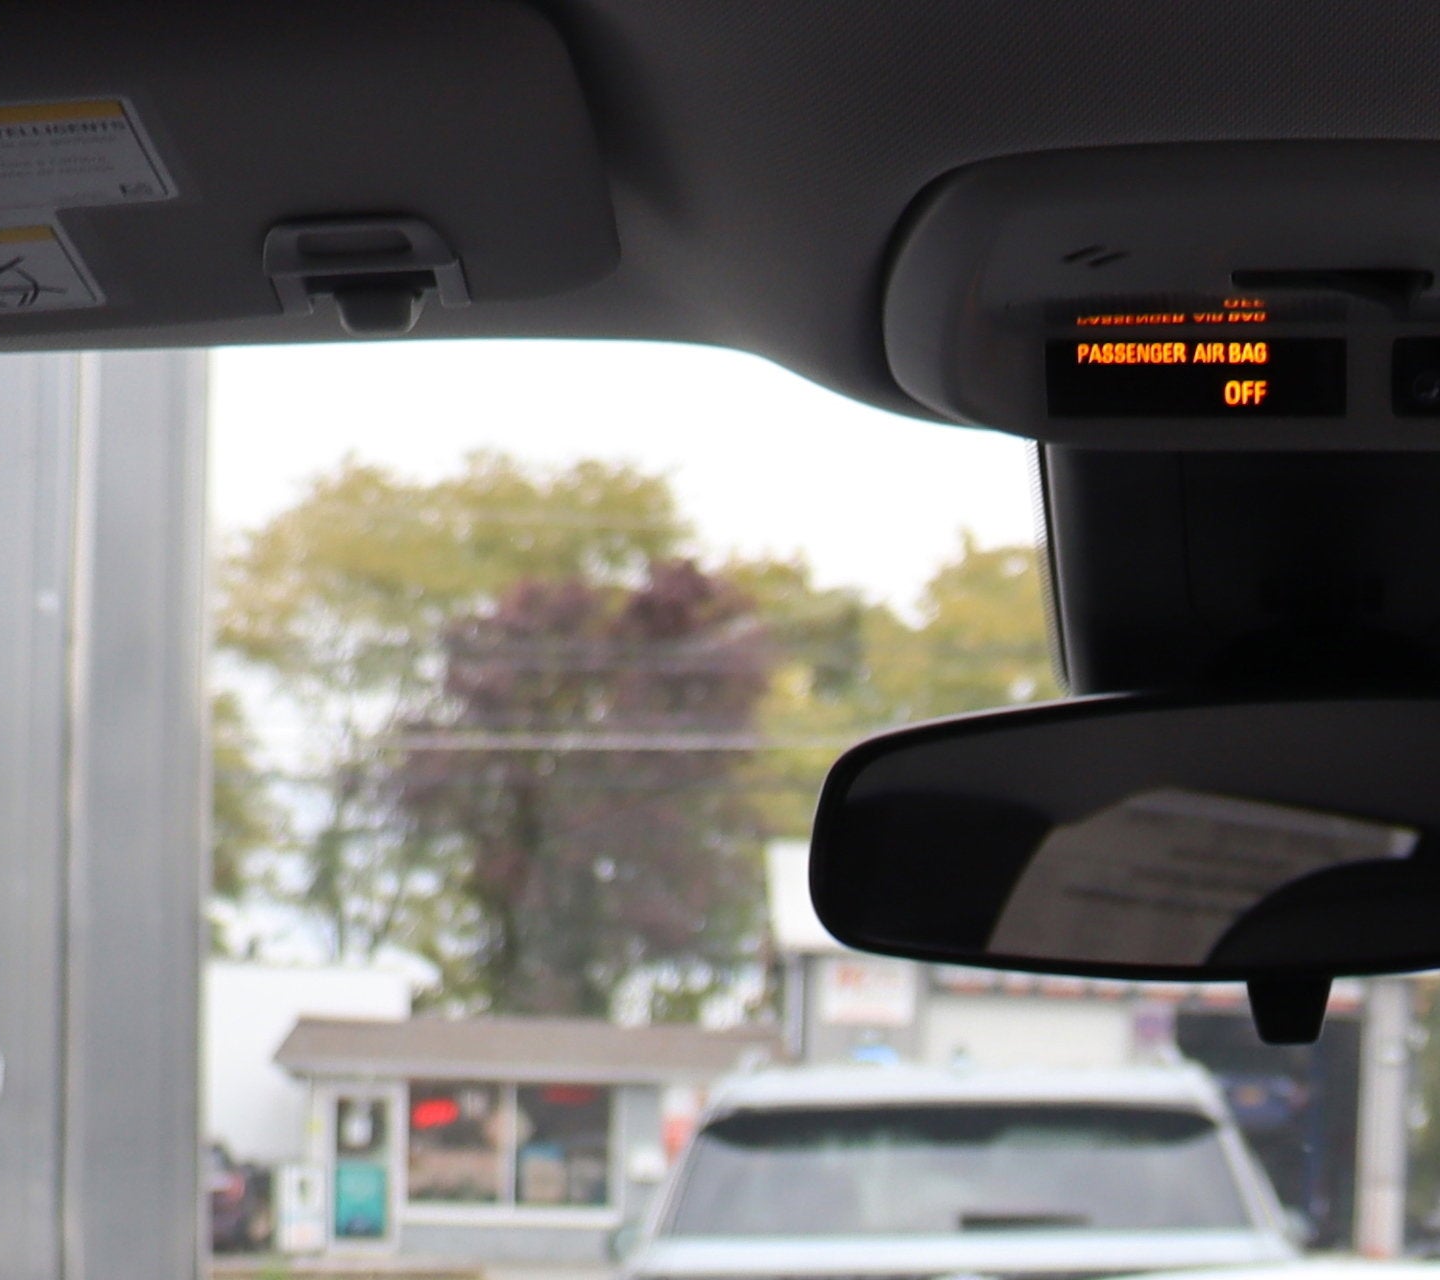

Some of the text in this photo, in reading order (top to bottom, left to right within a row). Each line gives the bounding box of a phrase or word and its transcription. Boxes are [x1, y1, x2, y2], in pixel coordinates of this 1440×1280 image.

[1077, 341, 1268, 365] PASSENGER AIR BAG
[1224, 379, 1268, 406] OFF
